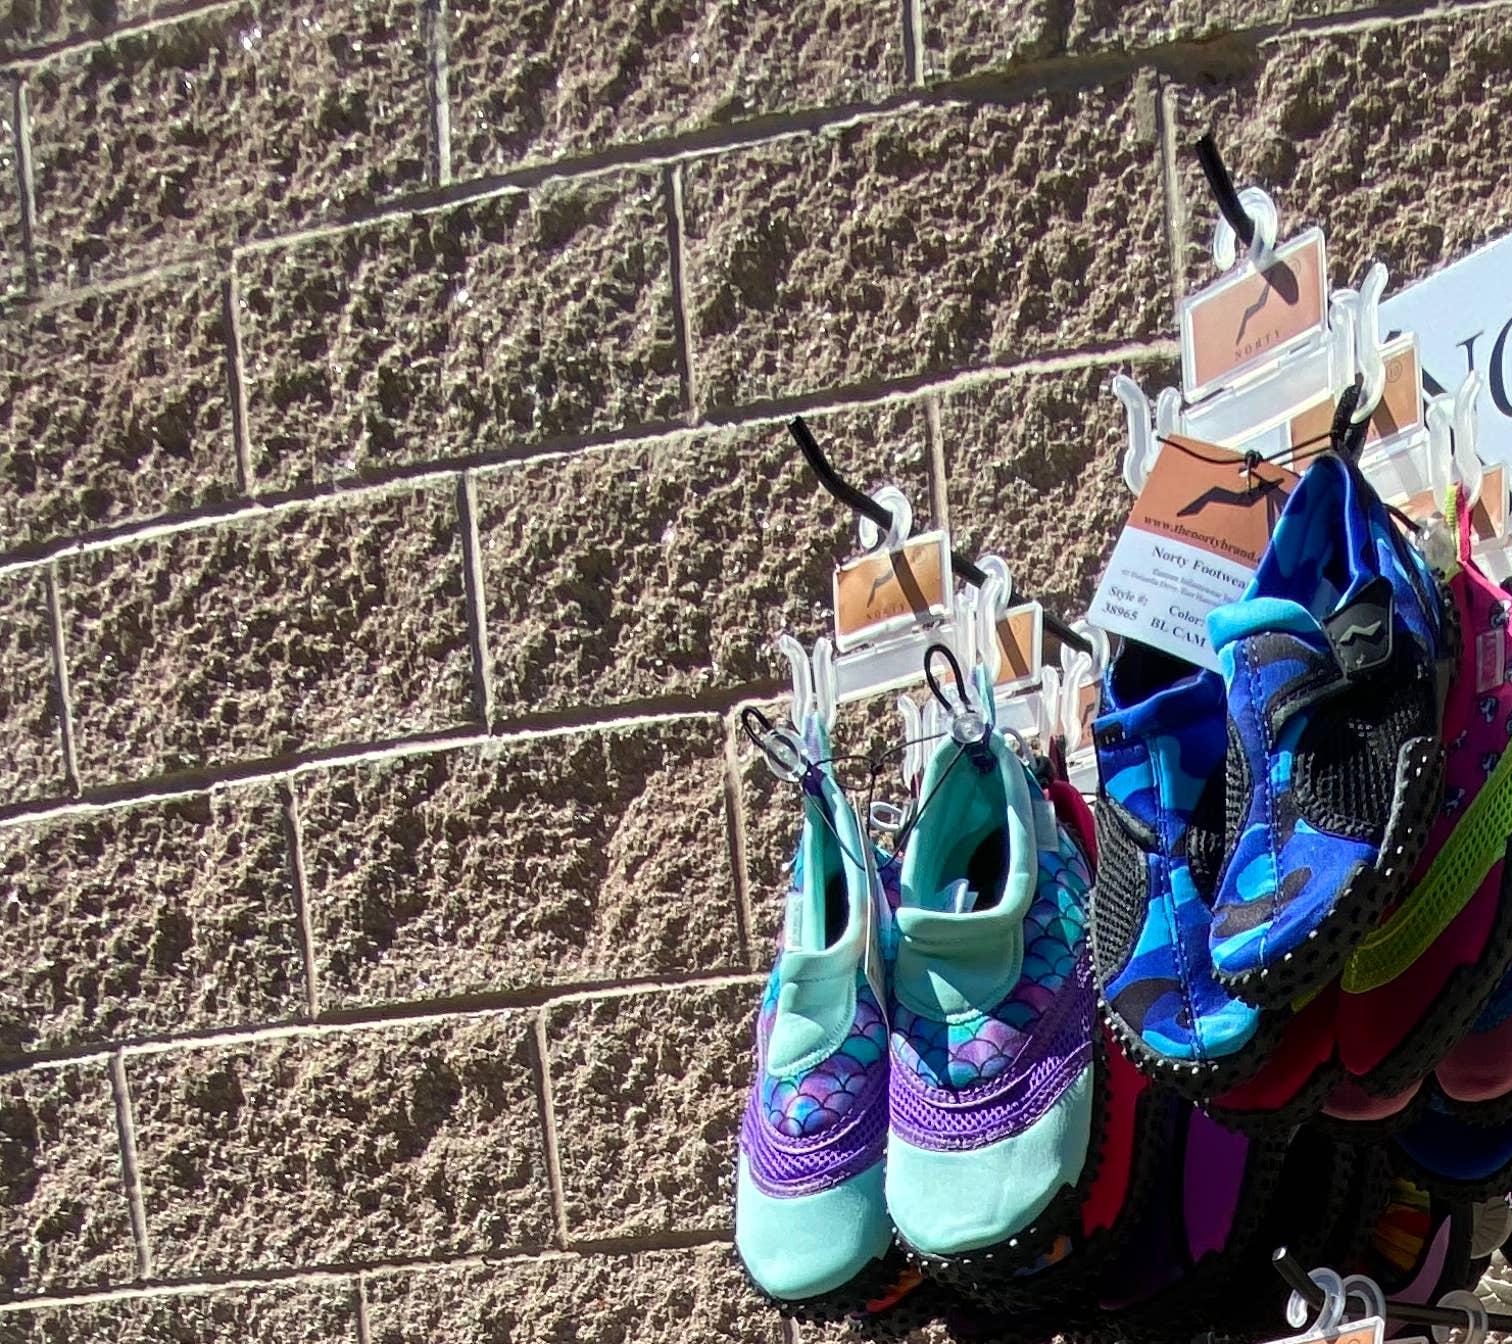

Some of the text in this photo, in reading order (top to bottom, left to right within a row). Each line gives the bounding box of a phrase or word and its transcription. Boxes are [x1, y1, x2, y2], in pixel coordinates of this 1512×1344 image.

[1235, 328, 1280, 361] NORTY
[1152, 545, 1188, 568] Norty
[1193, 559, 1248, 590] Footwea
[1102, 602, 1207, 648] 38965 BL CAM
[1109, 585, 1136, 602] Style
[1169, 604, 1204, 627] Color:
